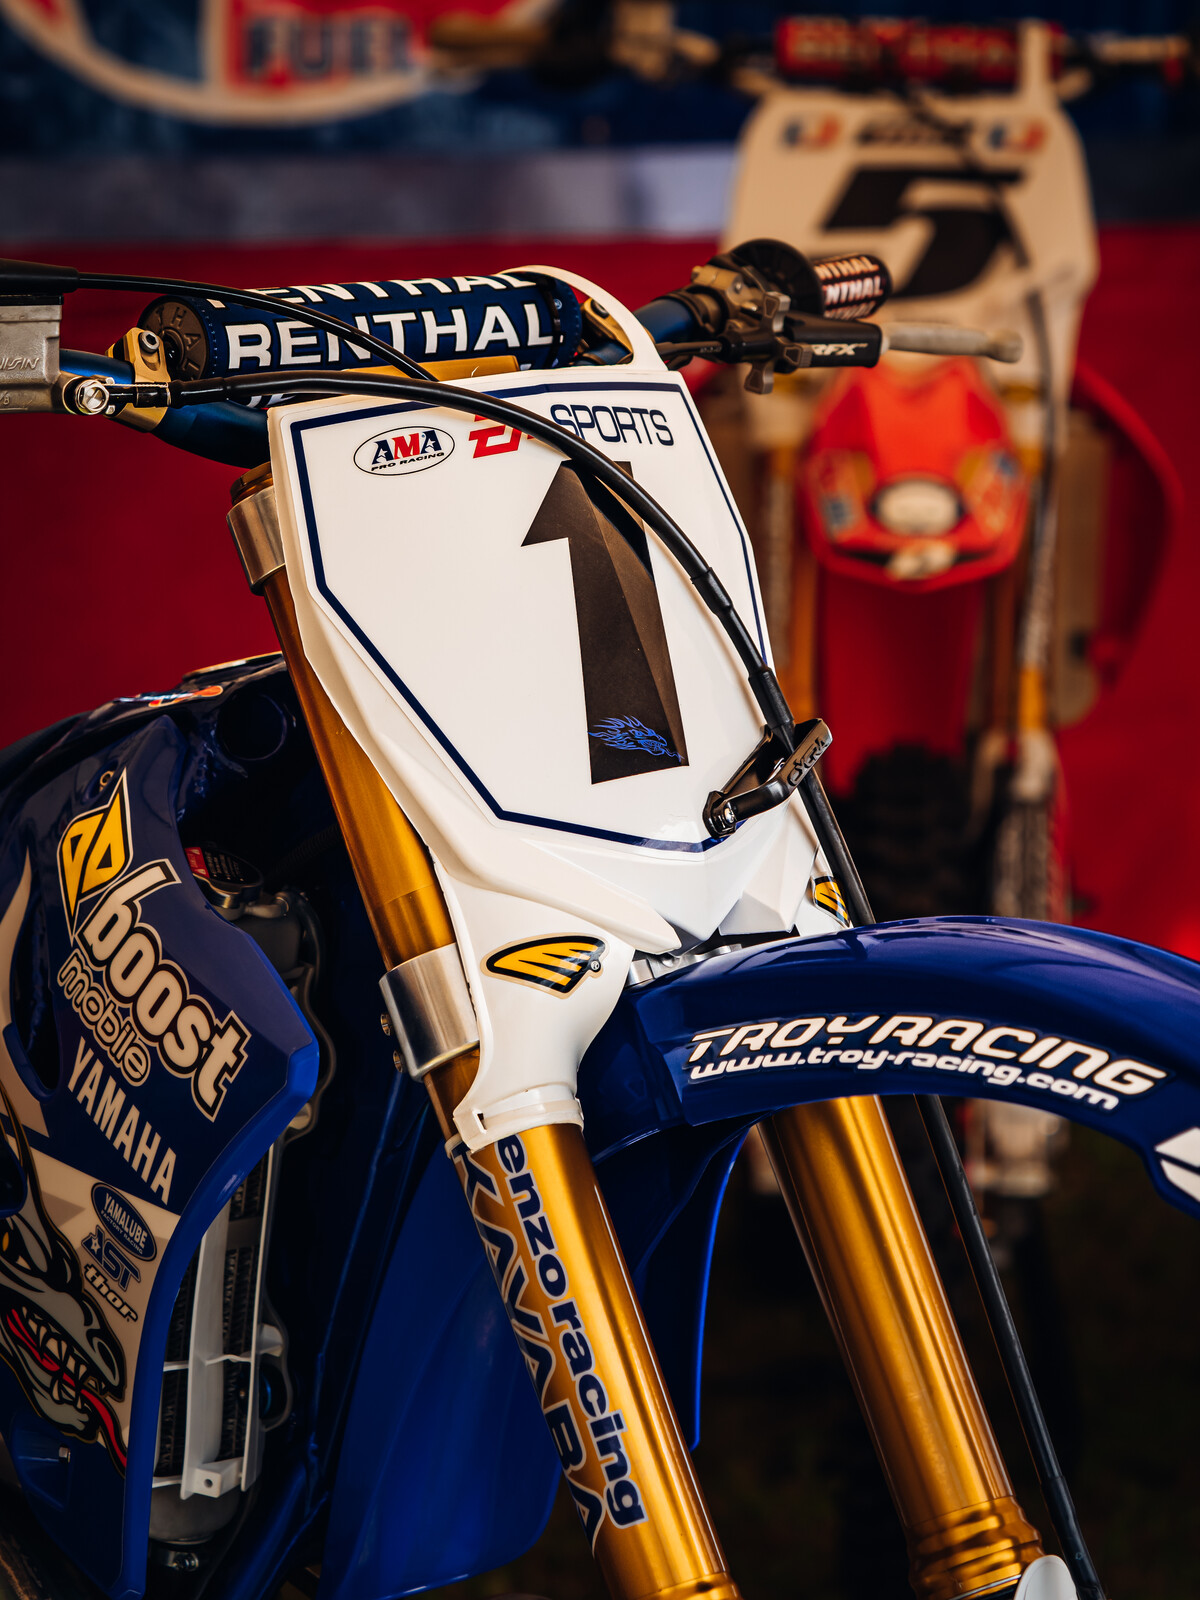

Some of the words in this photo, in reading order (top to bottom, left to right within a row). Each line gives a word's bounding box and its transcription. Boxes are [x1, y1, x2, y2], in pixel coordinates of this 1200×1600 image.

[820, 166, 1024, 300] 5
[225, 303, 563, 370] RENTHAL
[371, 429, 443, 465] AMA
[550, 403, 675, 446] SPORTS
[370, 461, 397, 472] PRO
[399, 451, 445, 465] RACING
[520, 460, 690, 785] 1
[57, 948, 151, 1087] mobile
[73, 858, 252, 1123] boost
[689, 1042, 1120, 1111] www.troy-racing.com
[67, 1035, 177, 1206] YAMAHA
[100, 1210, 124, 1237] FACTORY
[122, 1231, 144, 1256] RACING
[103, 1192, 149, 1249] YAMALUBE
[83, 1263, 139, 1322] thor
